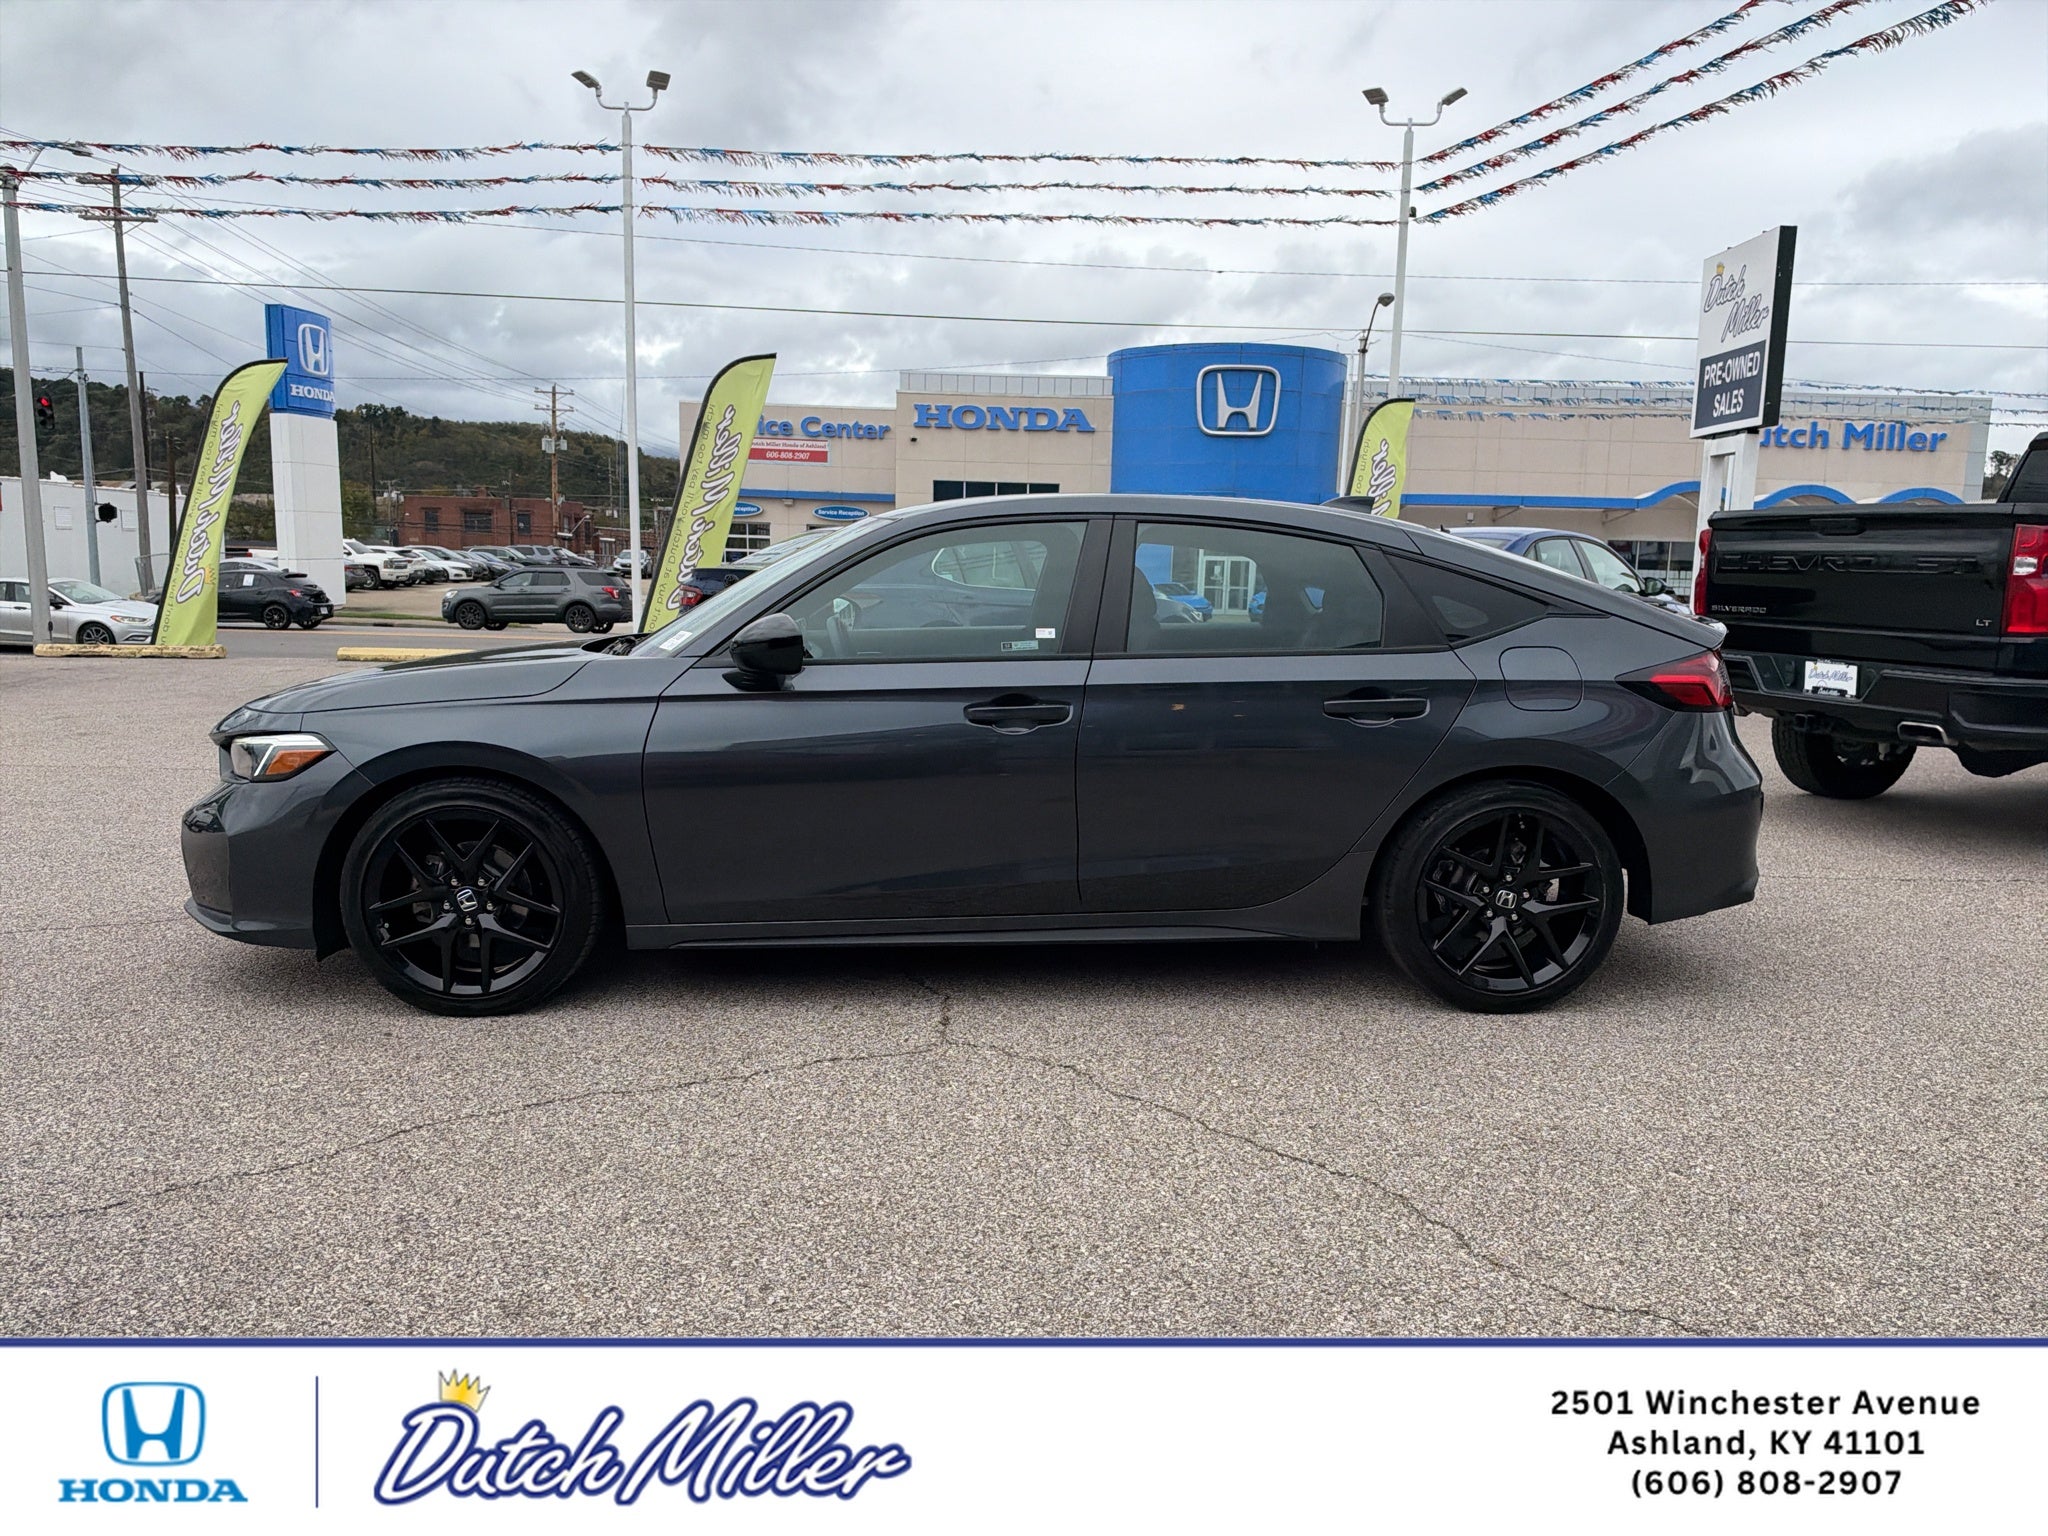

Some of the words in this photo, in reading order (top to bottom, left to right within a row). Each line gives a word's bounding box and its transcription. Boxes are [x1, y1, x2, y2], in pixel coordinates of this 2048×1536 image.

[1704, 264, 1747, 313] Dutch
[1720, 293, 1769, 343] Miller
[1703, 351, 1760, 389] PRE-OWNED
[290, 384, 335, 402] HONDA
[1713, 388, 1744, 418] SALES
[801, 416, 891, 440] Center
[913, 403, 1096, 433] HONDA
[1760, 421, 1829, 449] utch
[1841, 421, 1947, 452] Miller
[766, 450, 810, 460] 606-808-2907
[818, 508, 838, 516] Service
[838, 509, 865, 517] Reception
[1711, 604, 1767, 614] SILVERADO
[1975, 618, 1993, 627] LT
